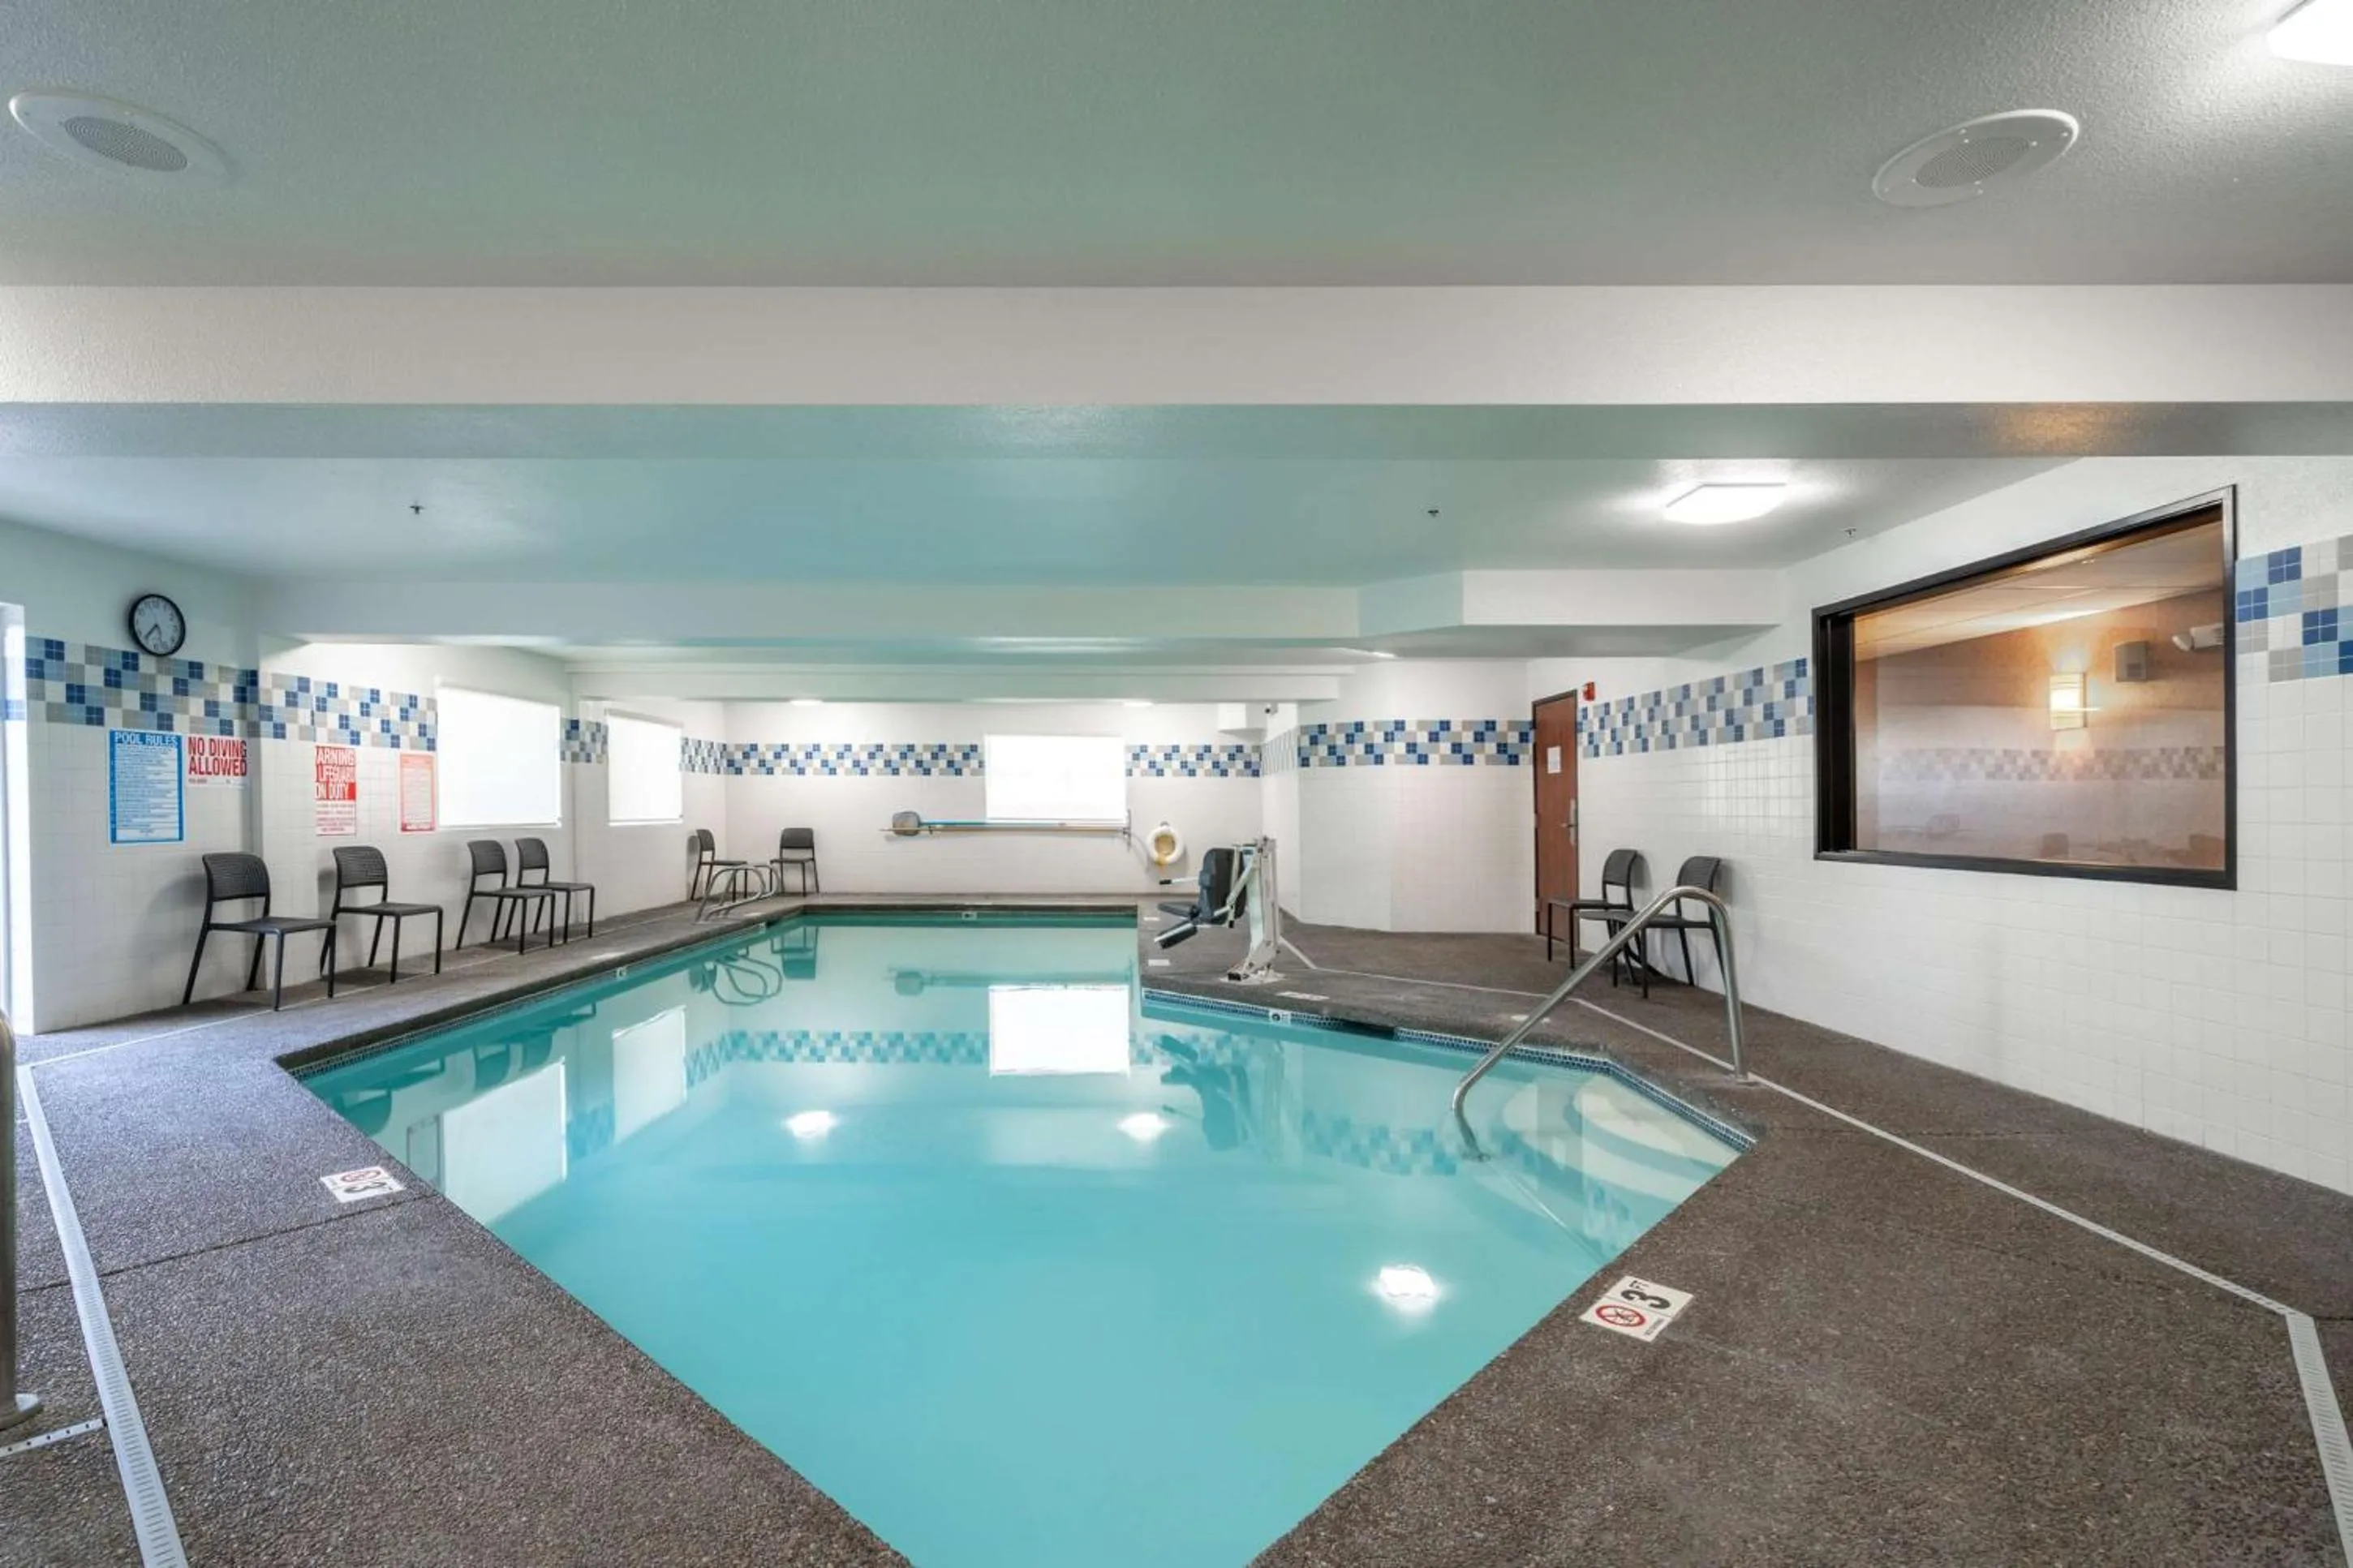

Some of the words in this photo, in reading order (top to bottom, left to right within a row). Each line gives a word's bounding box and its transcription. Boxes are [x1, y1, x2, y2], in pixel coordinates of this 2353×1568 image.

[115, 732, 142, 744] POOL
[146, 734, 178, 746] RULES
[189, 737, 204, 755] NO
[209, 738, 247, 758] DIVING
[316, 748, 355, 765] ARNING
[189, 757, 247, 776] ALLOWED
[315, 782, 327, 798] ON
[329, 782, 347, 799] DUTY
[1621, 1290, 1671, 1309] 3
